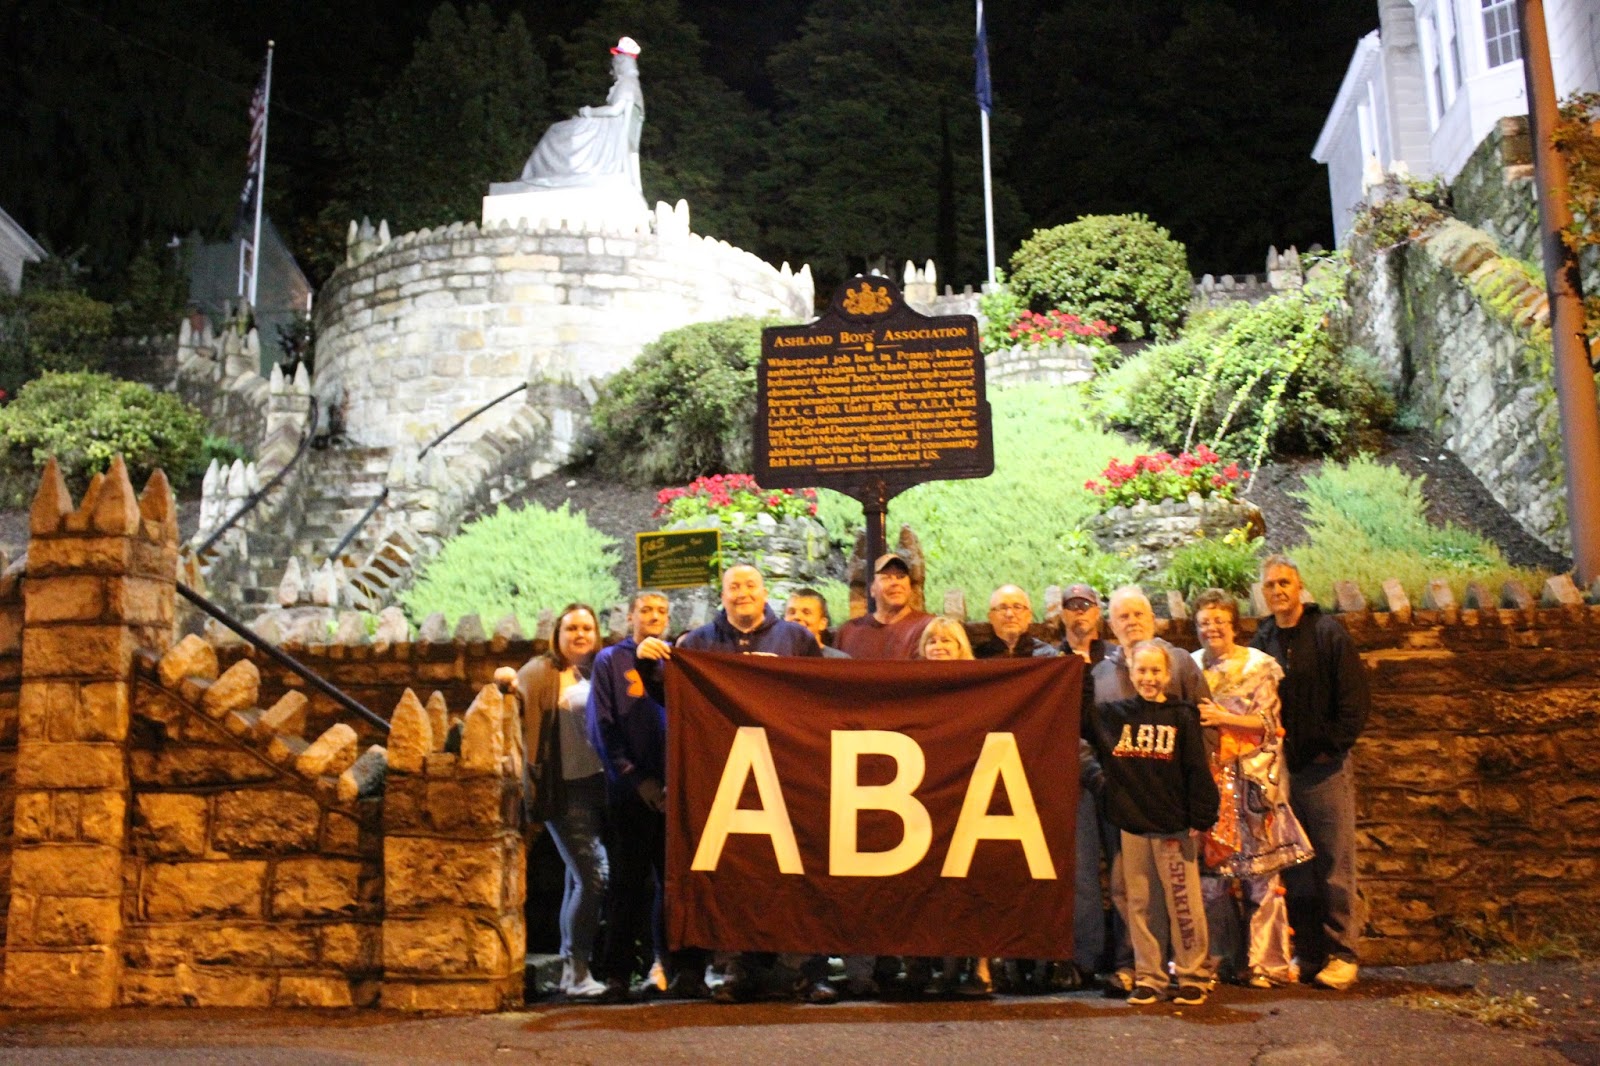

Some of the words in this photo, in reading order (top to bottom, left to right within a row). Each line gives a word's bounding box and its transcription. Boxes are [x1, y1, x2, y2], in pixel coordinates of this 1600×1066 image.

[773, 335, 833, 347] ASHLAND
[883, 327, 967, 340] ASSOCIATION
[767, 356, 828, 367] Widespread
[832, 354, 851, 366] job
[854, 353, 875, 362] loss
[880, 353, 891, 361] in
[897, 347, 974, 360] Pennsylvania's
[767, 367, 821, 377] anthracite
[822, 365, 855, 376] region
[857, 364, 868, 373] in
[869, 362, 886, 372] the
[887, 362, 907, 371] late
[908, 360, 930, 369] 19th
[932, 358, 974, 368] century
[811, 374, 850, 385] Ashland
[880, 372, 892, 381] to
[892, 370, 914, 380] seek
[914, 368, 975, 379] employment
[767, 387, 816, 397] elsewhere.
[816, 385, 850, 395] Strong
[851, 381, 907, 393] attachment
[909, 381, 920, 390] to
[921, 380, 938, 388] the
[768, 398, 800, 407] former
[800, 396, 850, 405] hometown
[850, 391, 898, 405] prompted
[899, 391, 946, 400] formation
[946, 388, 959, 397] of
[960, 388, 976, 397] the
[768, 407, 800, 417] A.B.A.
[815, 404, 841, 414] 1900.
[844, 403, 869, 413] Until
[899, 401, 917, 410] the
[919, 399, 952, 409] A.B.A.
[954, 397, 977, 407] held
[768, 417, 797, 427] Labor
[797, 416, 817, 426] Day
[817, 413, 878, 425] homecoming
[878, 411, 935, 421] celebrations
[935, 409, 953, 418] and
[768, 429, 784, 438] ing
[785, 427, 801, 436] the
[801, 425, 830, 435] Great
[830, 424, 885, 435] Depression
[885, 421, 915, 431] raised
[916, 419, 944, 430] funds
[944, 419, 960, 428] for
[961, 417, 977, 427] the
[912, 430, 921, 440] It
[921, 428, 978, 440] symbolizes
[768, 447, 806, 457] abiding
[806, 445, 852, 456] affection
[852, 443, 868, 453] for
[868, 443, 900, 453] family
[901, 440, 920, 451] and
[921, 439, 978, 449] community
[769, 457, 787, 467] felt
[788, 457, 813, 466] here
[814, 454, 835, 465] and
[837, 455, 849, 464] in
[850, 454, 868, 463] the
[869, 450, 920, 462] industrial
[690, 726, 1057, 879] ABA
[1169, 861, 1196, 950] SPARTANS
